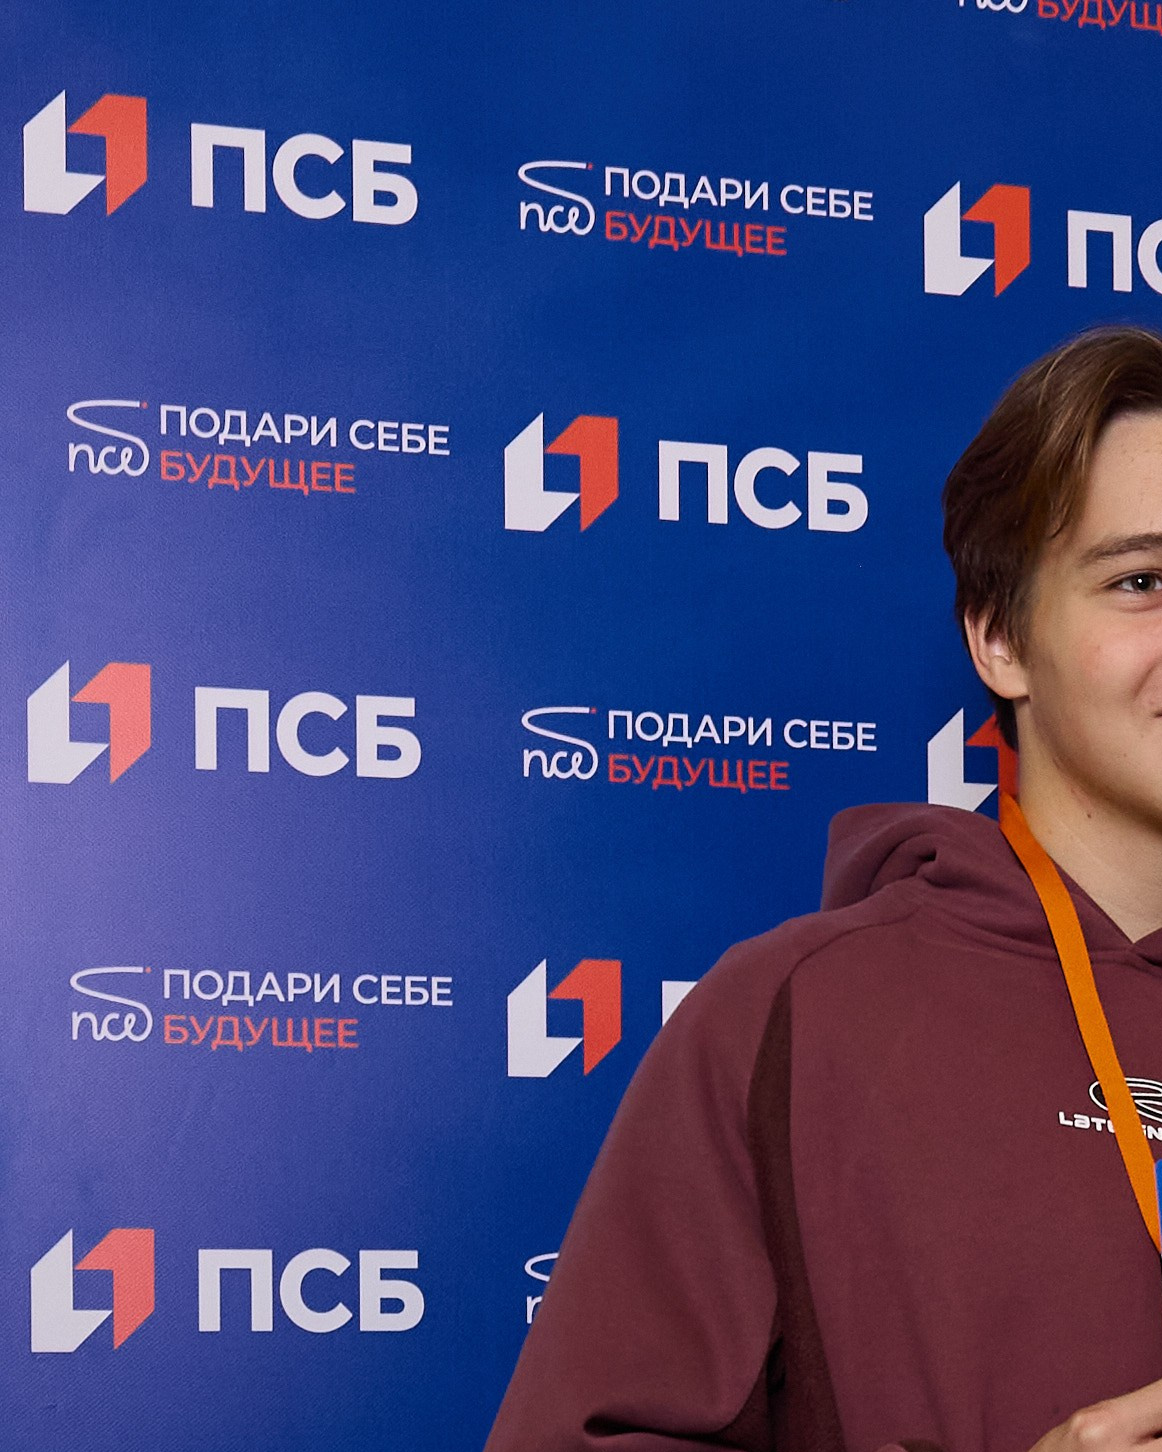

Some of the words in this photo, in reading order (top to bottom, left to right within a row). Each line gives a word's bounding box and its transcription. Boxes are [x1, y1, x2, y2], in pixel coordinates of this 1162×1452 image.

[191, 123, 418, 225] ПСБ
[605, 166, 768, 210] ПОДАРИ
[780, 184, 873, 221] СЕБЕ
[606, 211, 786, 256] БУДУЩЕЕ
[161, 405, 336, 447] ПОДАРИ
[349, 420, 450, 455] СЕБЕ
[160, 450, 355, 495] БУДУЩЕЕ
[659, 440, 868, 532] ПСБ
[195, 687, 421, 778] ПСБ
[609, 710, 771, 748] ПОДАРИ
[784, 719, 877, 751] СЕБЕ
[609, 754, 789, 792] БУДУЩЕЕ
[164, 969, 340, 1006] ПОДАРИ
[353, 974, 453, 1006] СЕБЕ
[165, 1015, 357, 1052] БУДУЩЕЕ
[198, 1248, 424, 1333] ПСБ
